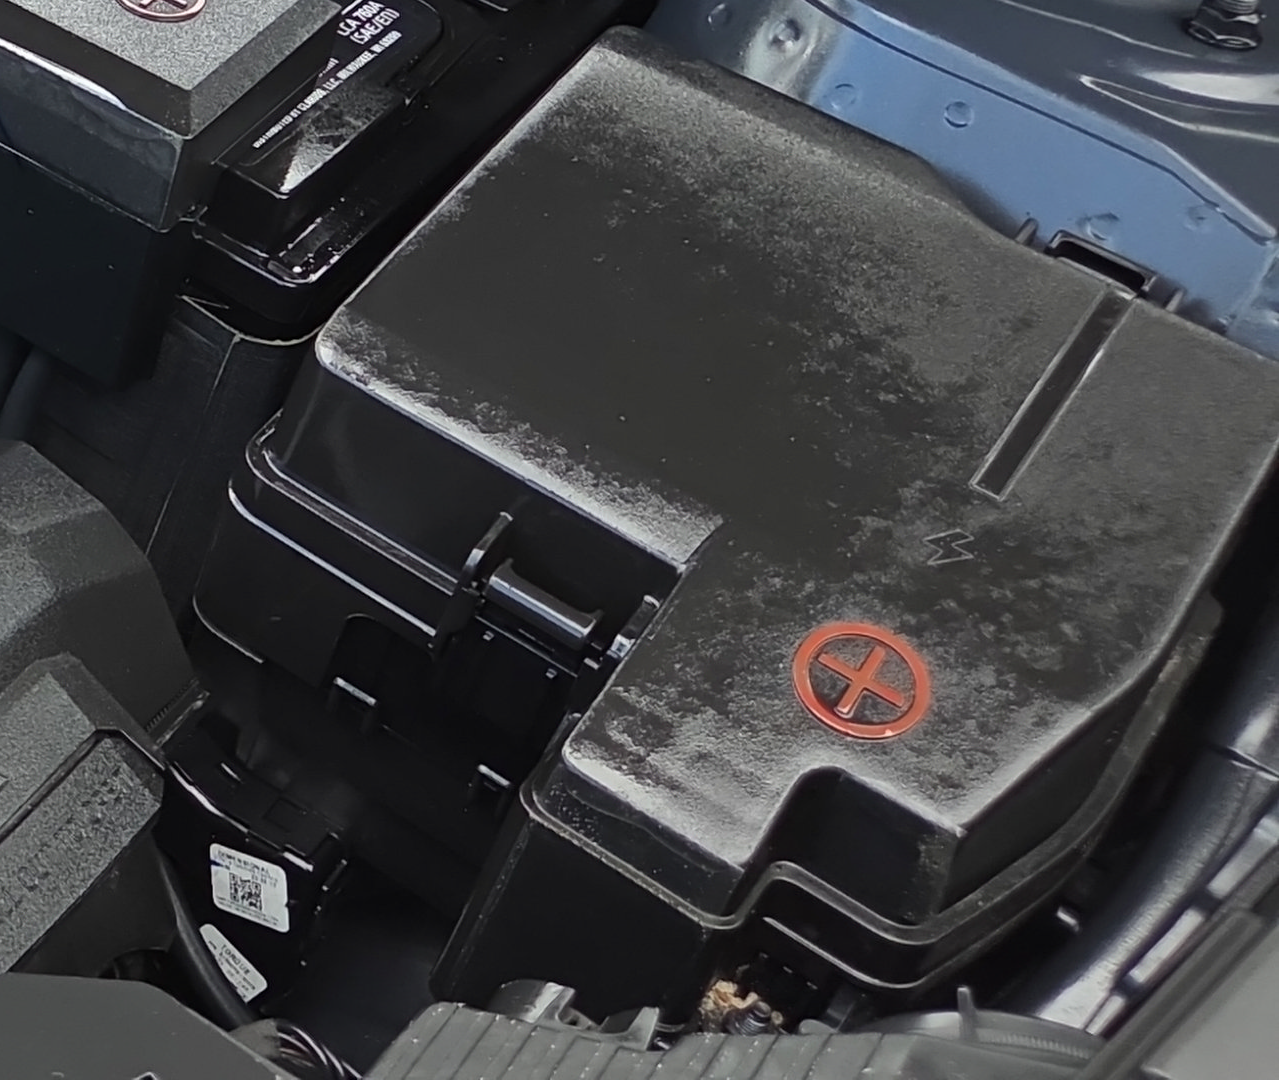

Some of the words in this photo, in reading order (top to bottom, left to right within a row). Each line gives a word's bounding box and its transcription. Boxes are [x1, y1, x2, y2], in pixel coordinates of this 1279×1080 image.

[336, 16, 361, 37] LCA
[352, 0, 385, 22] 760A
[221, 944, 250, 975] TORQUE
